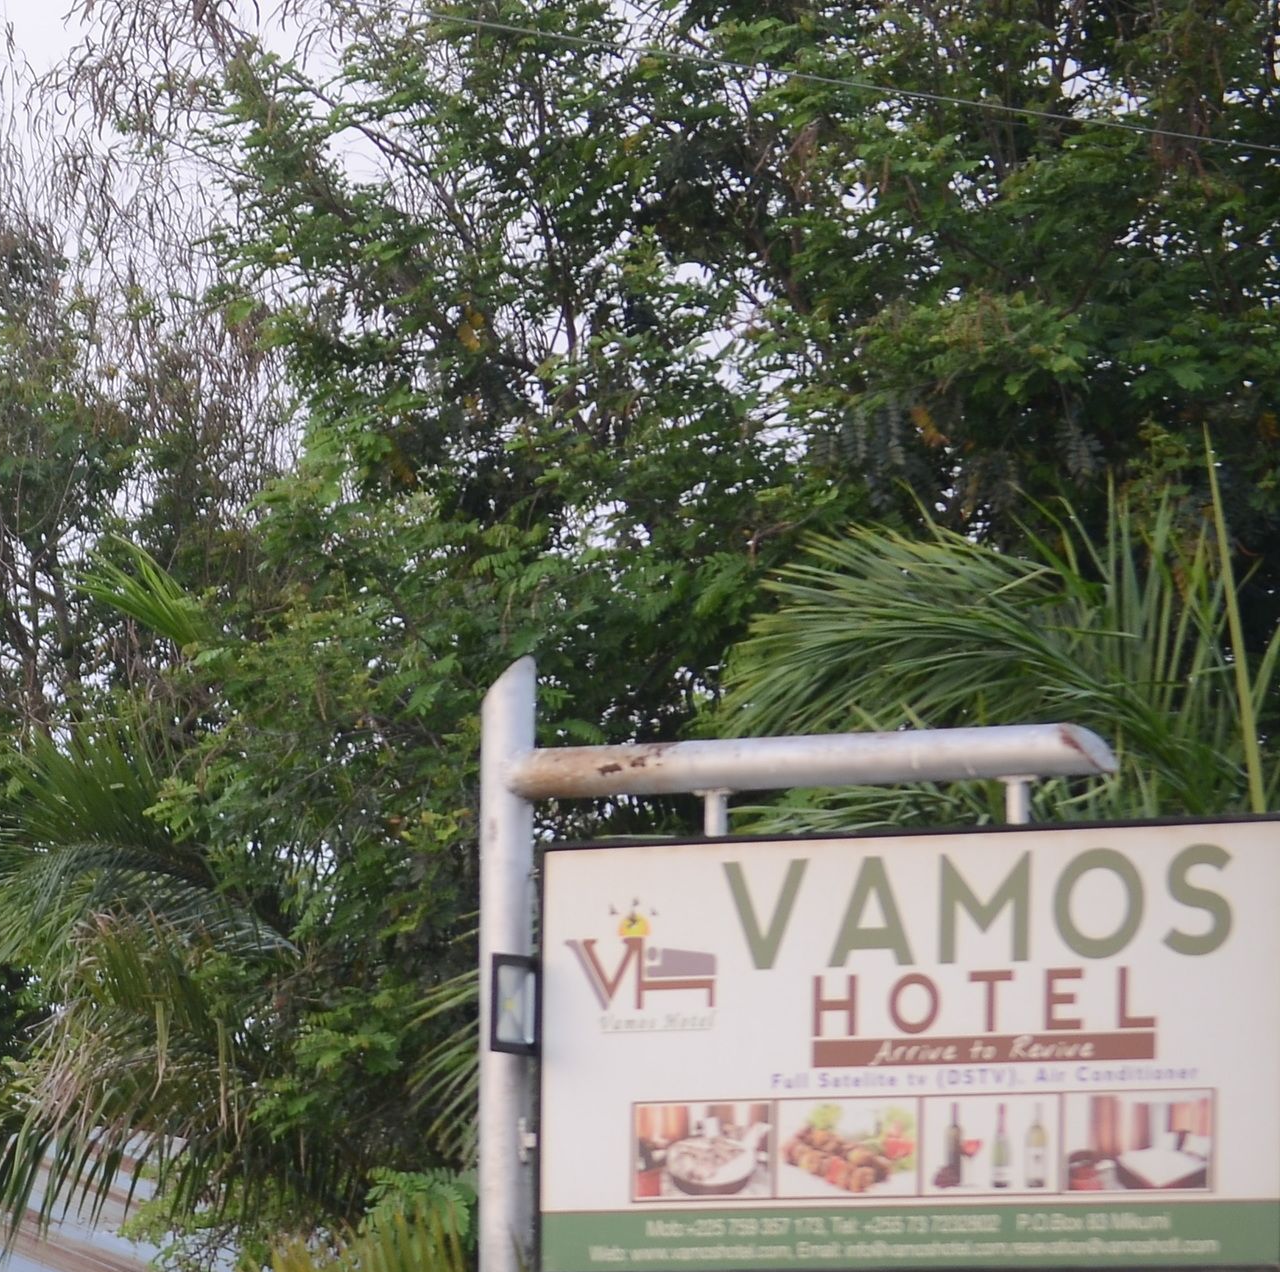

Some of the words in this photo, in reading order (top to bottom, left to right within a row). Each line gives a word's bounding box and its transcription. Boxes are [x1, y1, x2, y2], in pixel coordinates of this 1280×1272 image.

[722, 843, 1233, 970] VAMOS
[812, 966, 1157, 1037] HOTEL
[867, 1039, 958, 1066] Arrive
[968, 1039, 998, 1061] to
[1008, 1034, 1095, 1060] Revive
[771, 1073, 810, 1089] Full
[1034, 1067, 1066, 1083] Air
[1074, 1064, 1200, 1083] Conditioner
